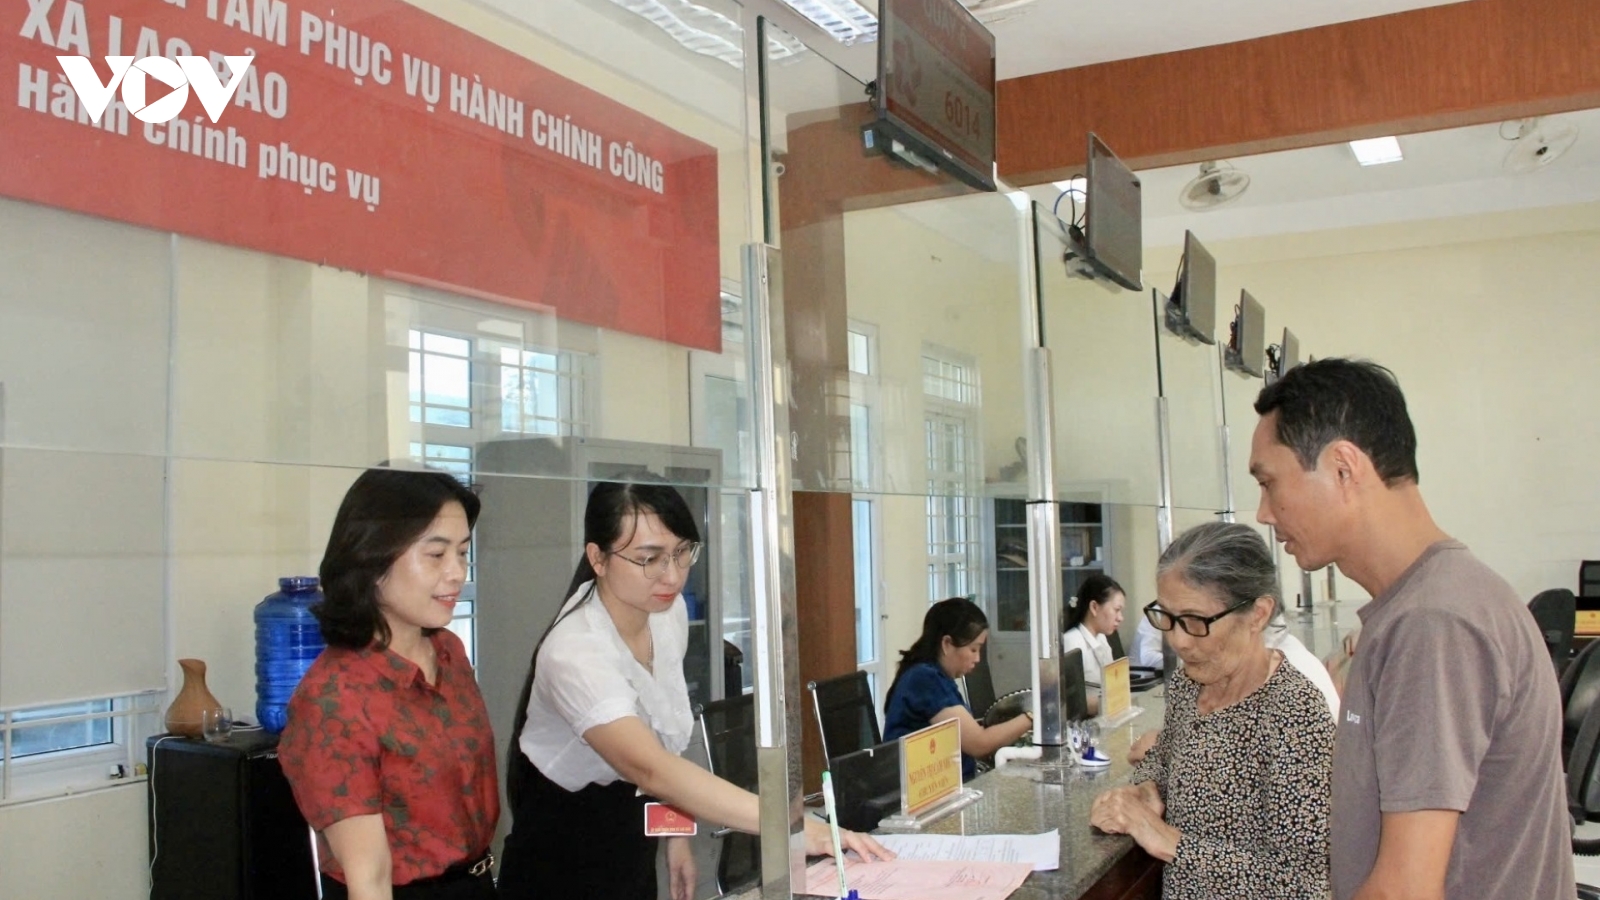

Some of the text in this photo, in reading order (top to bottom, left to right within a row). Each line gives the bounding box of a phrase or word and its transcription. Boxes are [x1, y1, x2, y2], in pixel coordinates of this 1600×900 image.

[300, 10, 392, 86] PHỤC
[402, 52, 440, 113] VỤ
[449, 72, 524, 138] HÀNH
[532, 108, 602, 170] CHÍNH
[609, 141, 664, 194] CÔNG
[944, 91, 981, 141] 6014
[258, 141, 337, 195] phục
[346, 168, 380, 212] vụ
